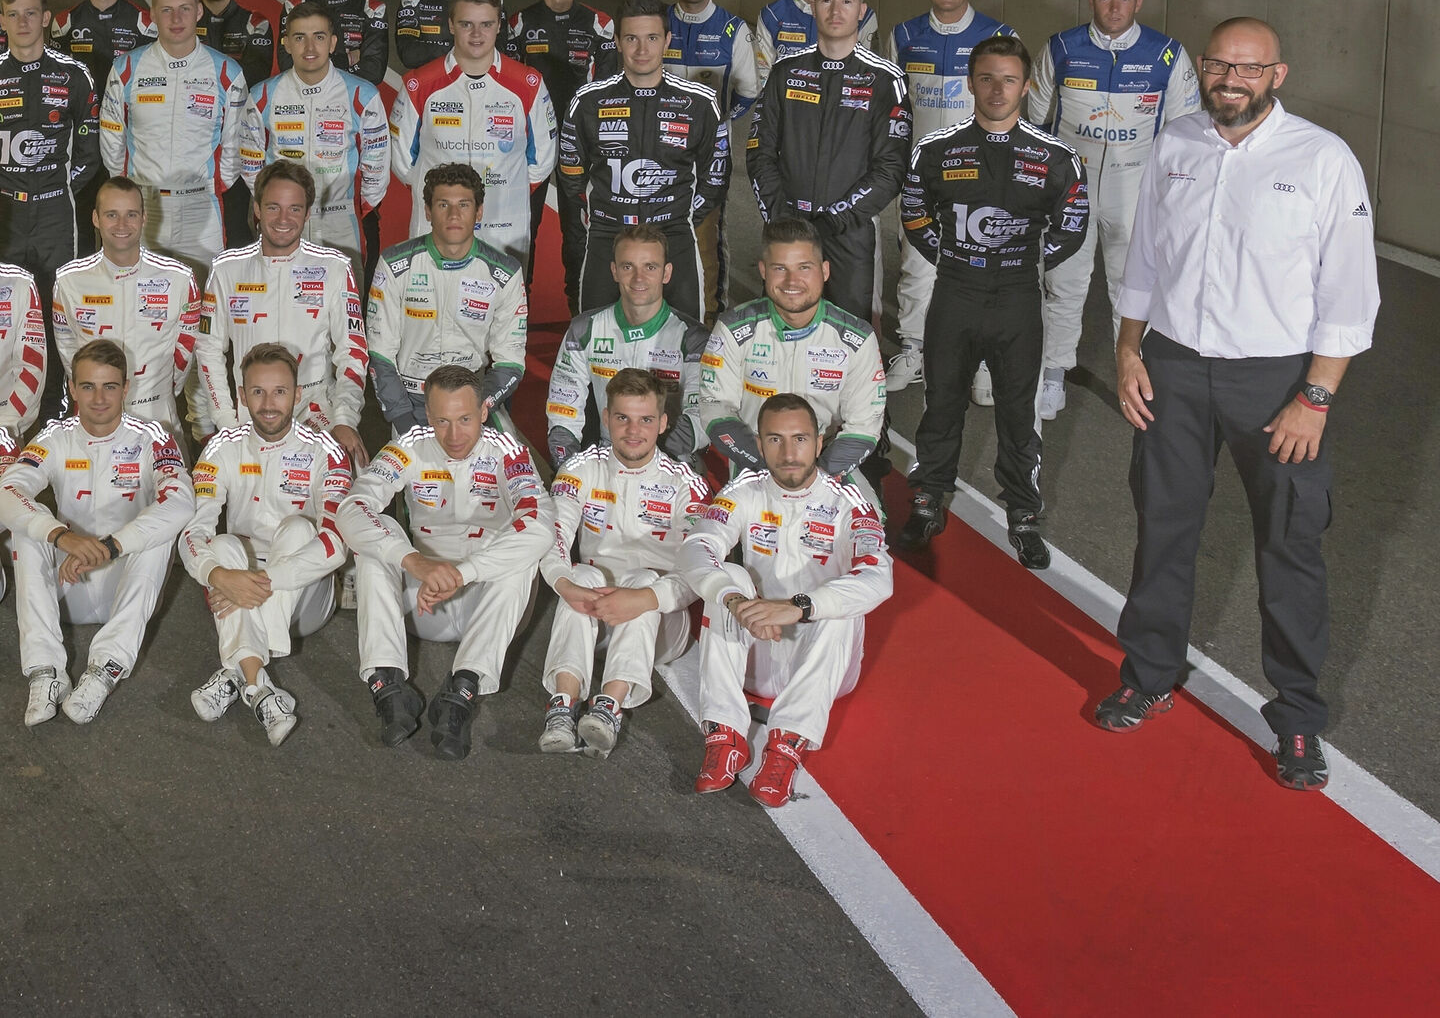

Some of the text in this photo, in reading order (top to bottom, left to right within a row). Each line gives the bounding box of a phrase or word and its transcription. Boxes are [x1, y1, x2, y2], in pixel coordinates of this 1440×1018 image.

[916, 84, 944, 95] Power
[789, 91, 819, 103] PIRELLI
[1075, 123, 1137, 142] JACOBS
[436, 139, 495, 150] hutchison
[24, 145, 57, 156] WRT
[1025, 163, 1047, 172] TOTAL
[636, 176, 677, 185] WRT
[945, 170, 977, 180] PIRELLI
[611, 196, 639, 204] 2009
[984, 225, 1029, 235] WRT
[956, 241, 987, 252] 2009
[391, 260, 409, 271] OMP
[470, 301, 489, 309] TOTAL
[734, 326, 753, 340] OMP
[844, 330, 864, 345] OMP
[648, 503, 670, 512] TOTAL
[811, 523, 833, 533] TOTAL
